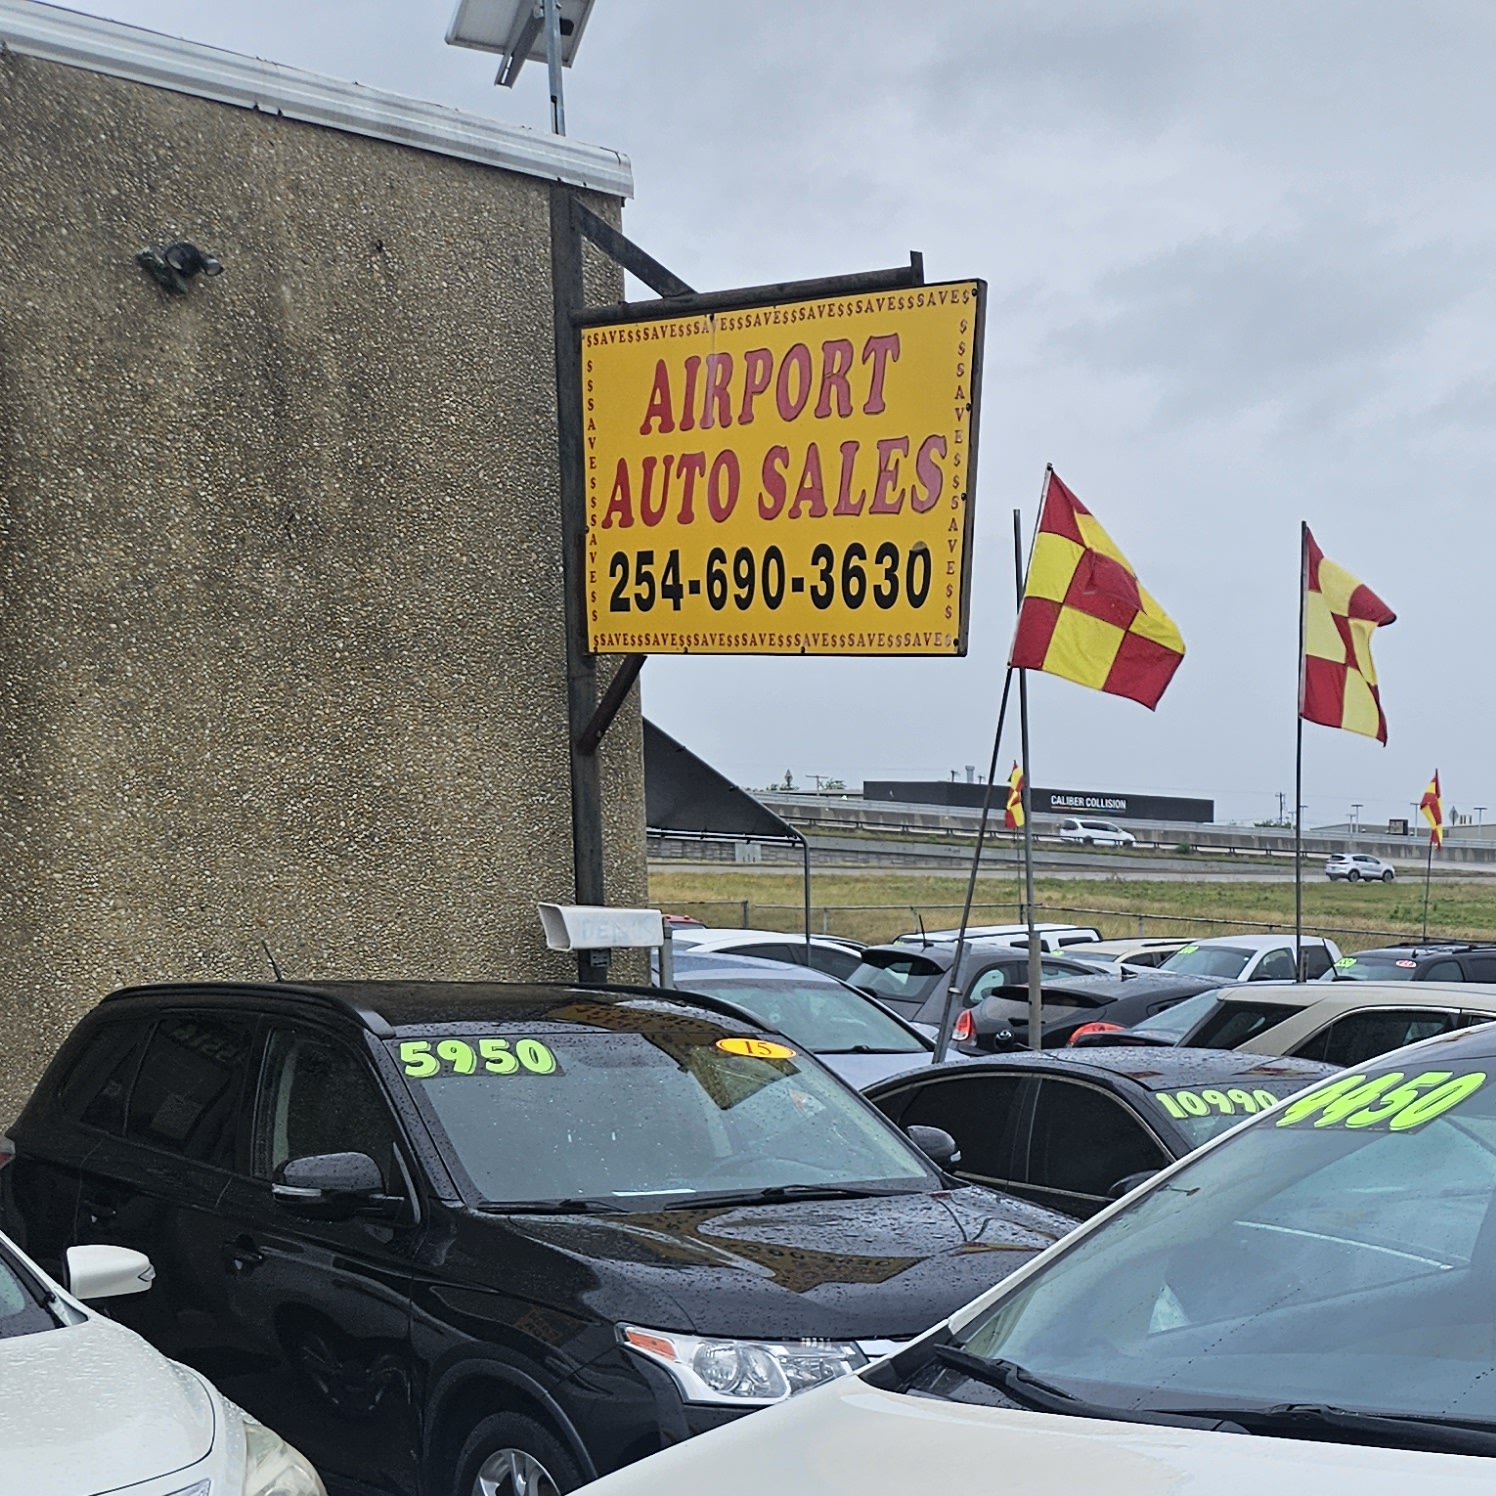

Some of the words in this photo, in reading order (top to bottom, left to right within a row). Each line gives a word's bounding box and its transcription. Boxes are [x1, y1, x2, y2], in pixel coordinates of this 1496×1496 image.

[640, 332, 900, 436] AIRPORT
[601, 448, 741, 530] AUTO
[758, 434, 948, 520] SALES
[608, 541, 932, 613] 254-690-3630
[1050, 795, 1084, 807] CALIBER
[1085, 798, 1126, 809] COLLISION
[400, 1038, 557, 1078] 5950
[743, 1041, 772, 1056] 15
[1155, 1088, 1280, 1120] 10990
[1275, 1072, 1488, 1131] 4450
